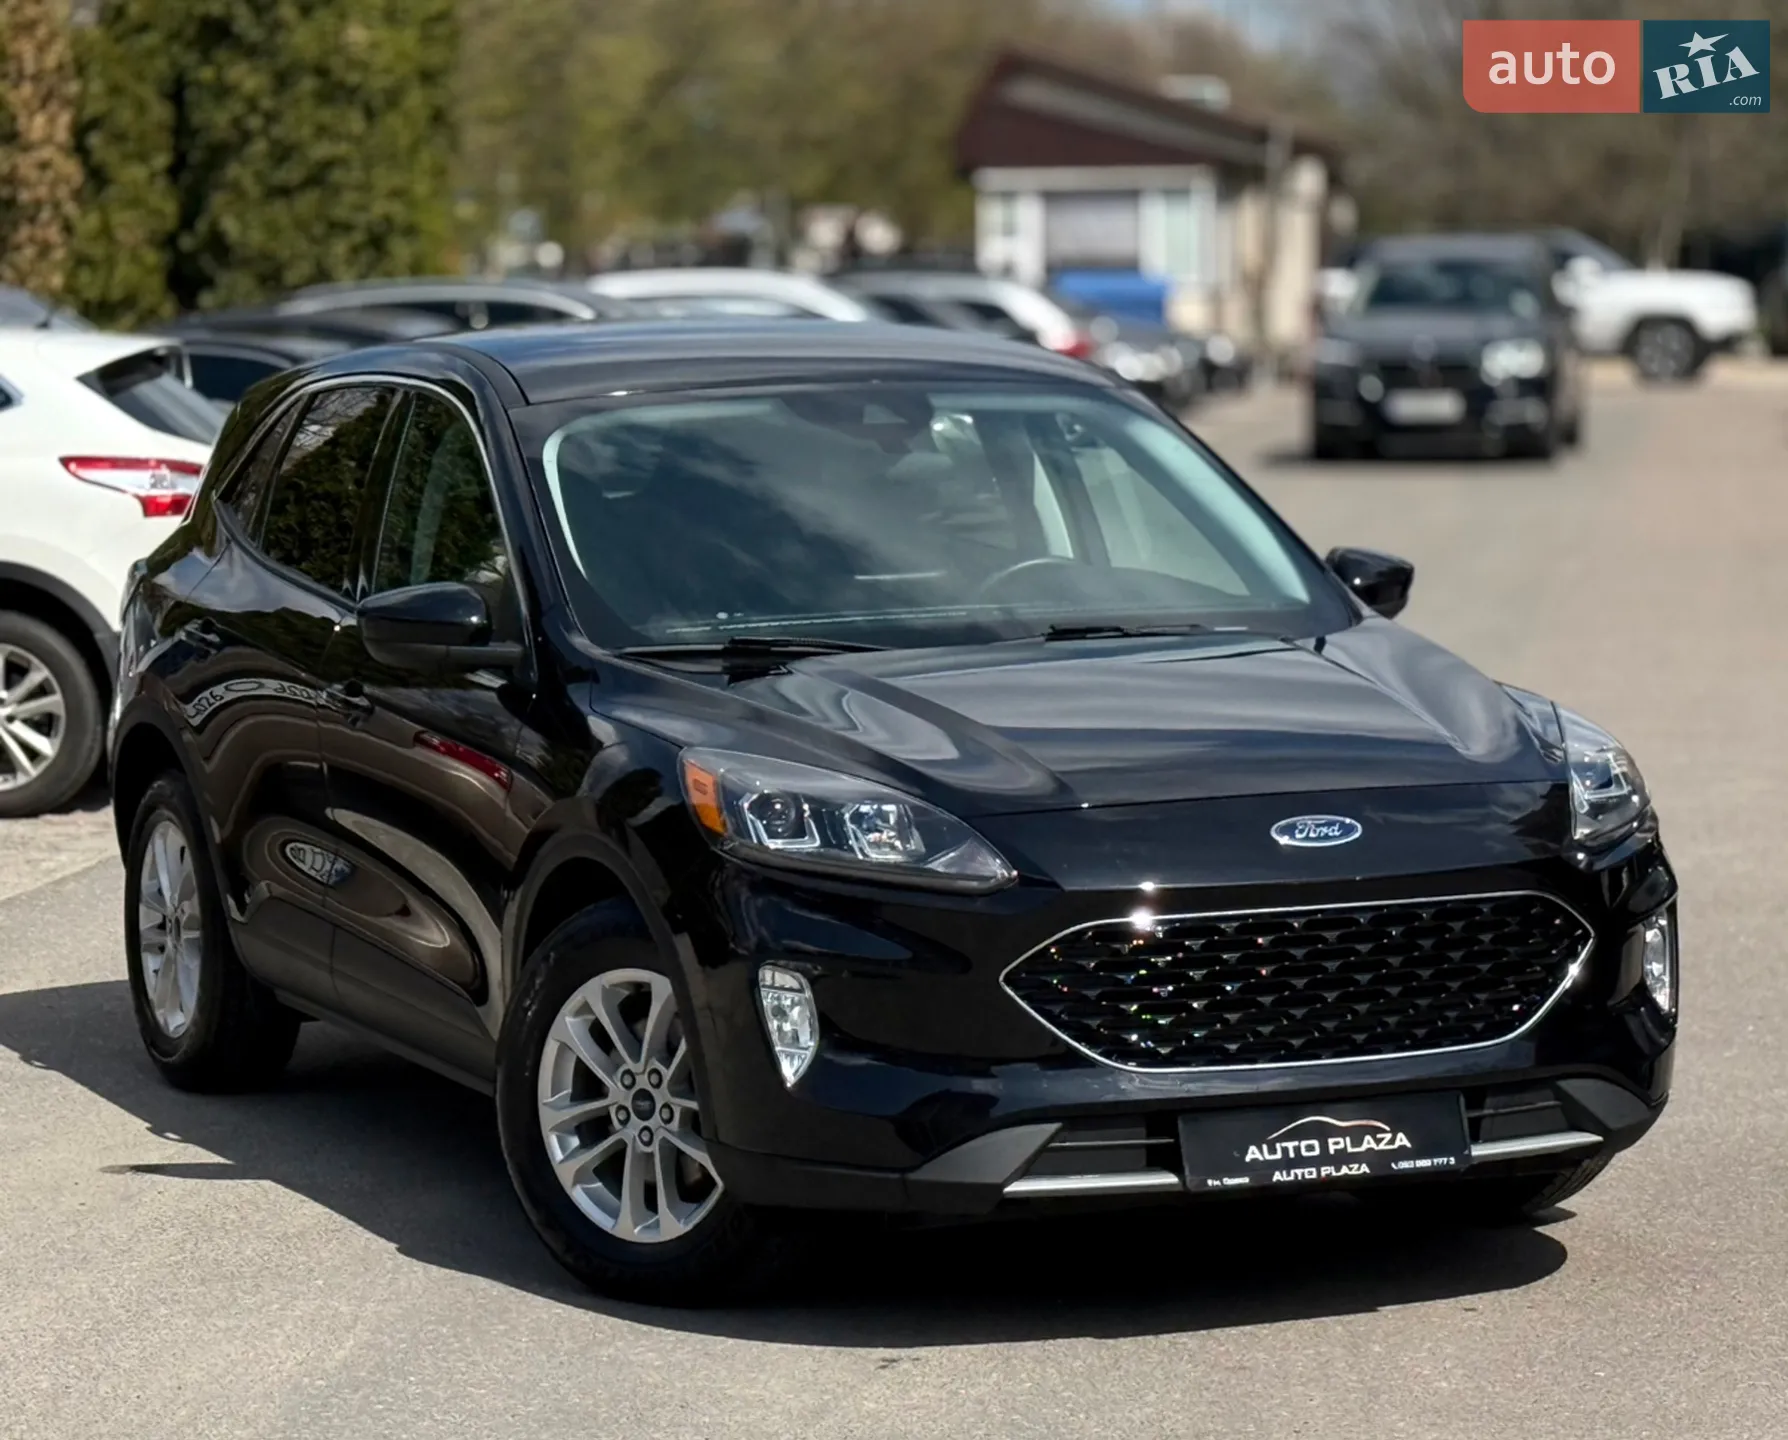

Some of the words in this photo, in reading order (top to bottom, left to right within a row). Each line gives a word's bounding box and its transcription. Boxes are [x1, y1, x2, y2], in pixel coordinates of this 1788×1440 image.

[1295, 820, 1343, 838] Ford
[1245, 1139, 1320, 1162] AUTO
[1328, 1132, 1412, 1155] PLAZA
[1272, 1166, 1317, 1182] AUTO
[1320, 1163, 1370, 1177] PLAZA
